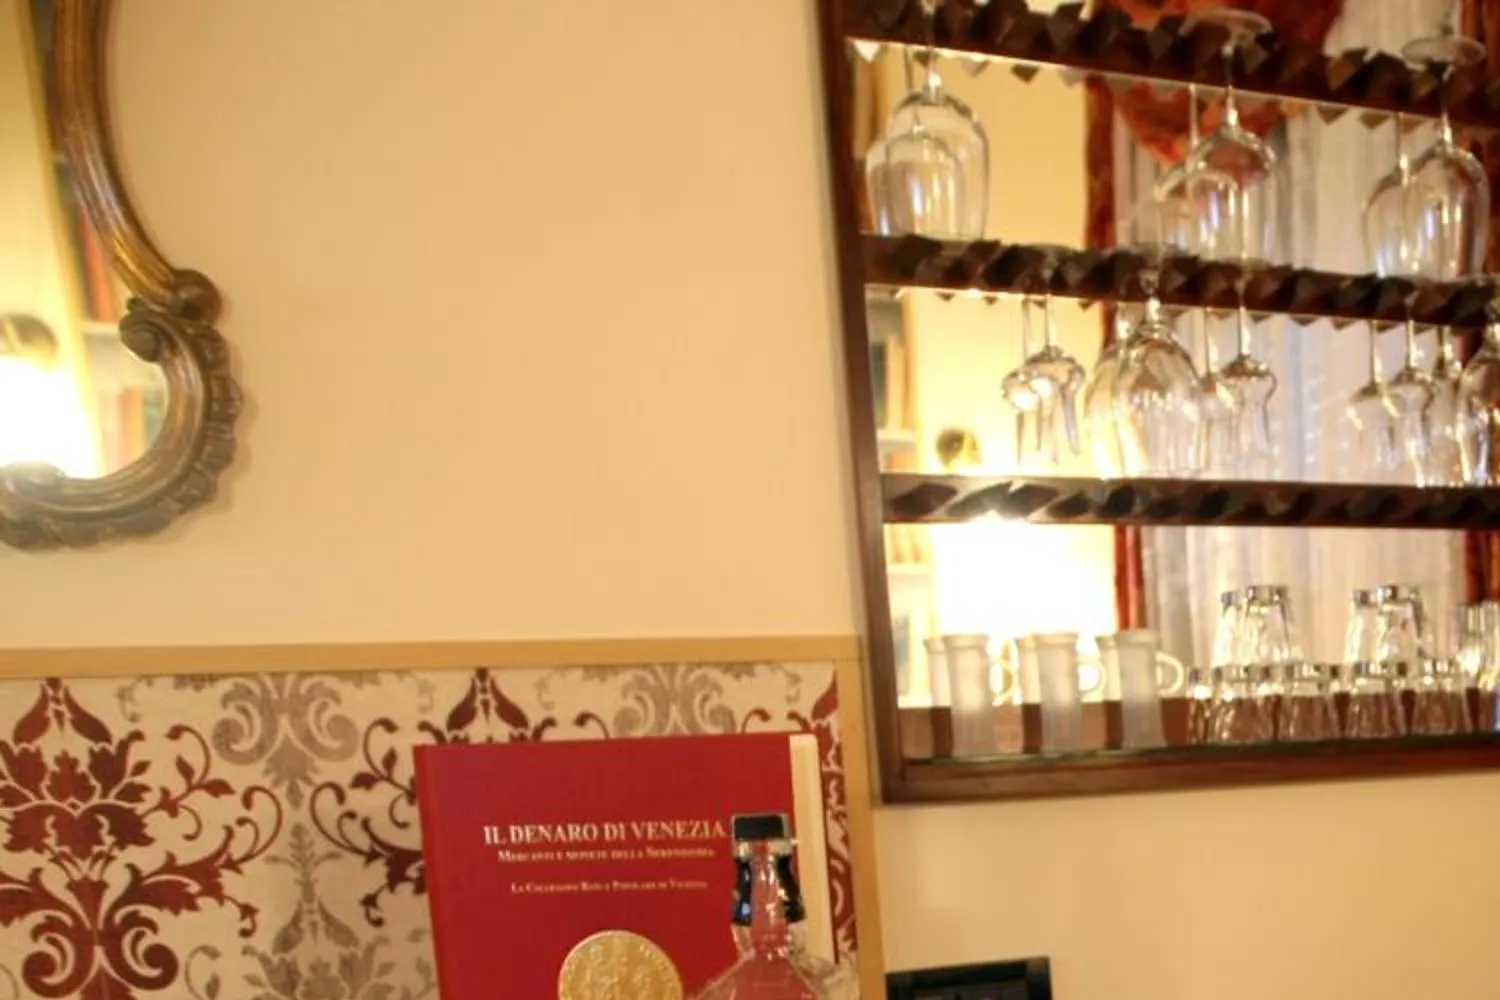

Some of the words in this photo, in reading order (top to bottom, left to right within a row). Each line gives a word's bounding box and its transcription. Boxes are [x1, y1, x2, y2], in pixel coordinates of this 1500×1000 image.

[483, 825, 507, 845] IL
[509, 822, 598, 844] DENARO
[603, 821, 626, 841] DI
[631, 819, 727, 840] VENEZIA
